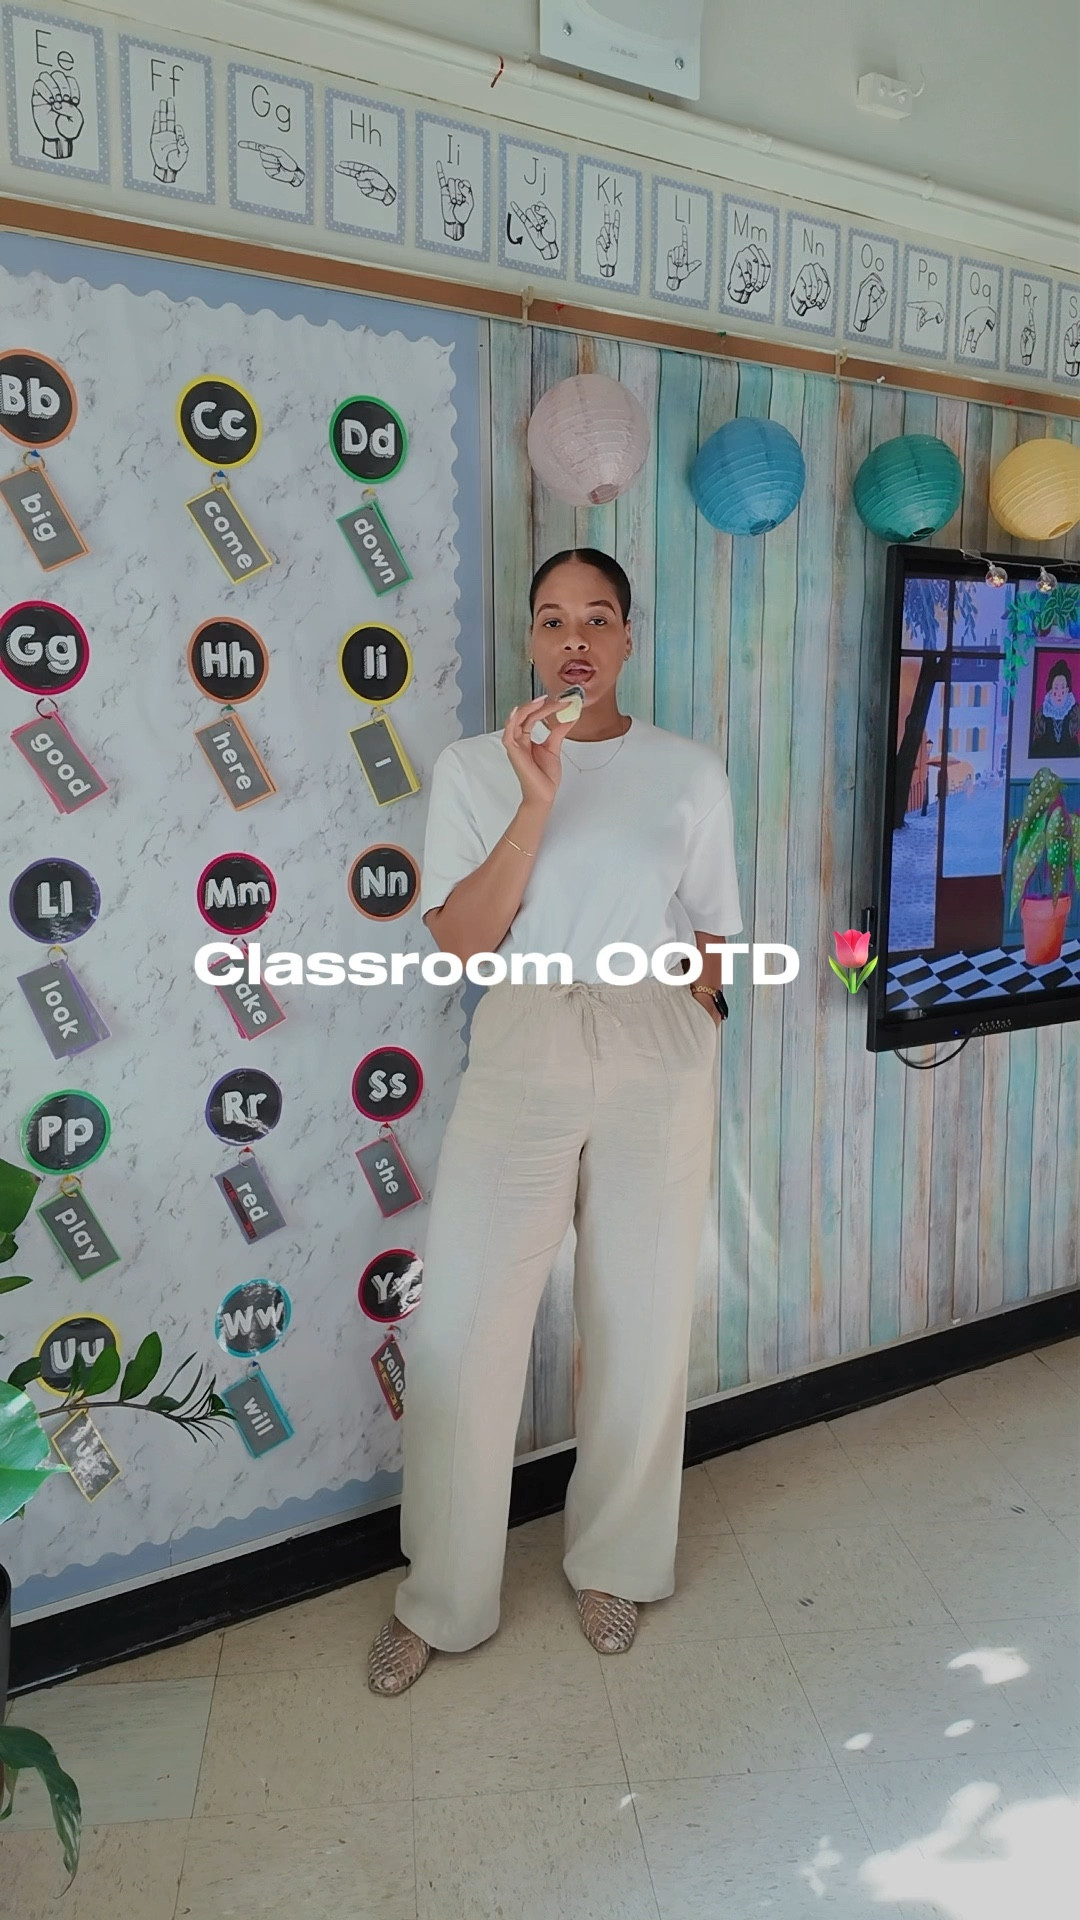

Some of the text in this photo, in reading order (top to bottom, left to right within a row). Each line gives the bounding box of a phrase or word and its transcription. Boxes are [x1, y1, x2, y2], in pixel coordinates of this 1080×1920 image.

[35, 29, 76, 72] Ee
[150, 58, 184, 97] Ff
[251, 85, 291, 132] Gg
[350, 110, 382, 147] Hh
[446, 134, 461, 166] Ii
[523, 157, 548, 196] Jj
[597, 174, 623, 207] Kk
[733, 210, 768, 243] Mm
[803, 228, 825, 257] Nn
[861, 243, 885, 272] Oo
[918, 258, 938, 291] Pp
[969, 271, 992, 305] Qq
[1022, 283, 1038, 308] Rr
[0, 374, 61, 420] Bb
[191, 400, 248, 441] Cc
[341, 418, 397, 459] Dd
[20, 492, 58, 543] big
[204, 500, 253, 570] come
[353, 518, 397, 585] down
[5, 625, 78, 674] Gg
[201, 641, 256, 679] Hh
[30, 732, 92, 798] good
[212, 732, 253, 792] here
[204, 877, 271, 910] Mm
[359, 865, 409, 898] Nn
[40, 980, 79, 1040] look
[220, 962, 267, 1025] ake
[368, 1069, 408, 1102] Ss
[221, 1090, 267, 1124] Rr
[38, 1114, 94, 1155] Pp
[375, 1157, 400, 1196] she
[235, 1181, 270, 1223] red
[54, 1208, 101, 1262] play
[243, 1396, 275, 1438] will
